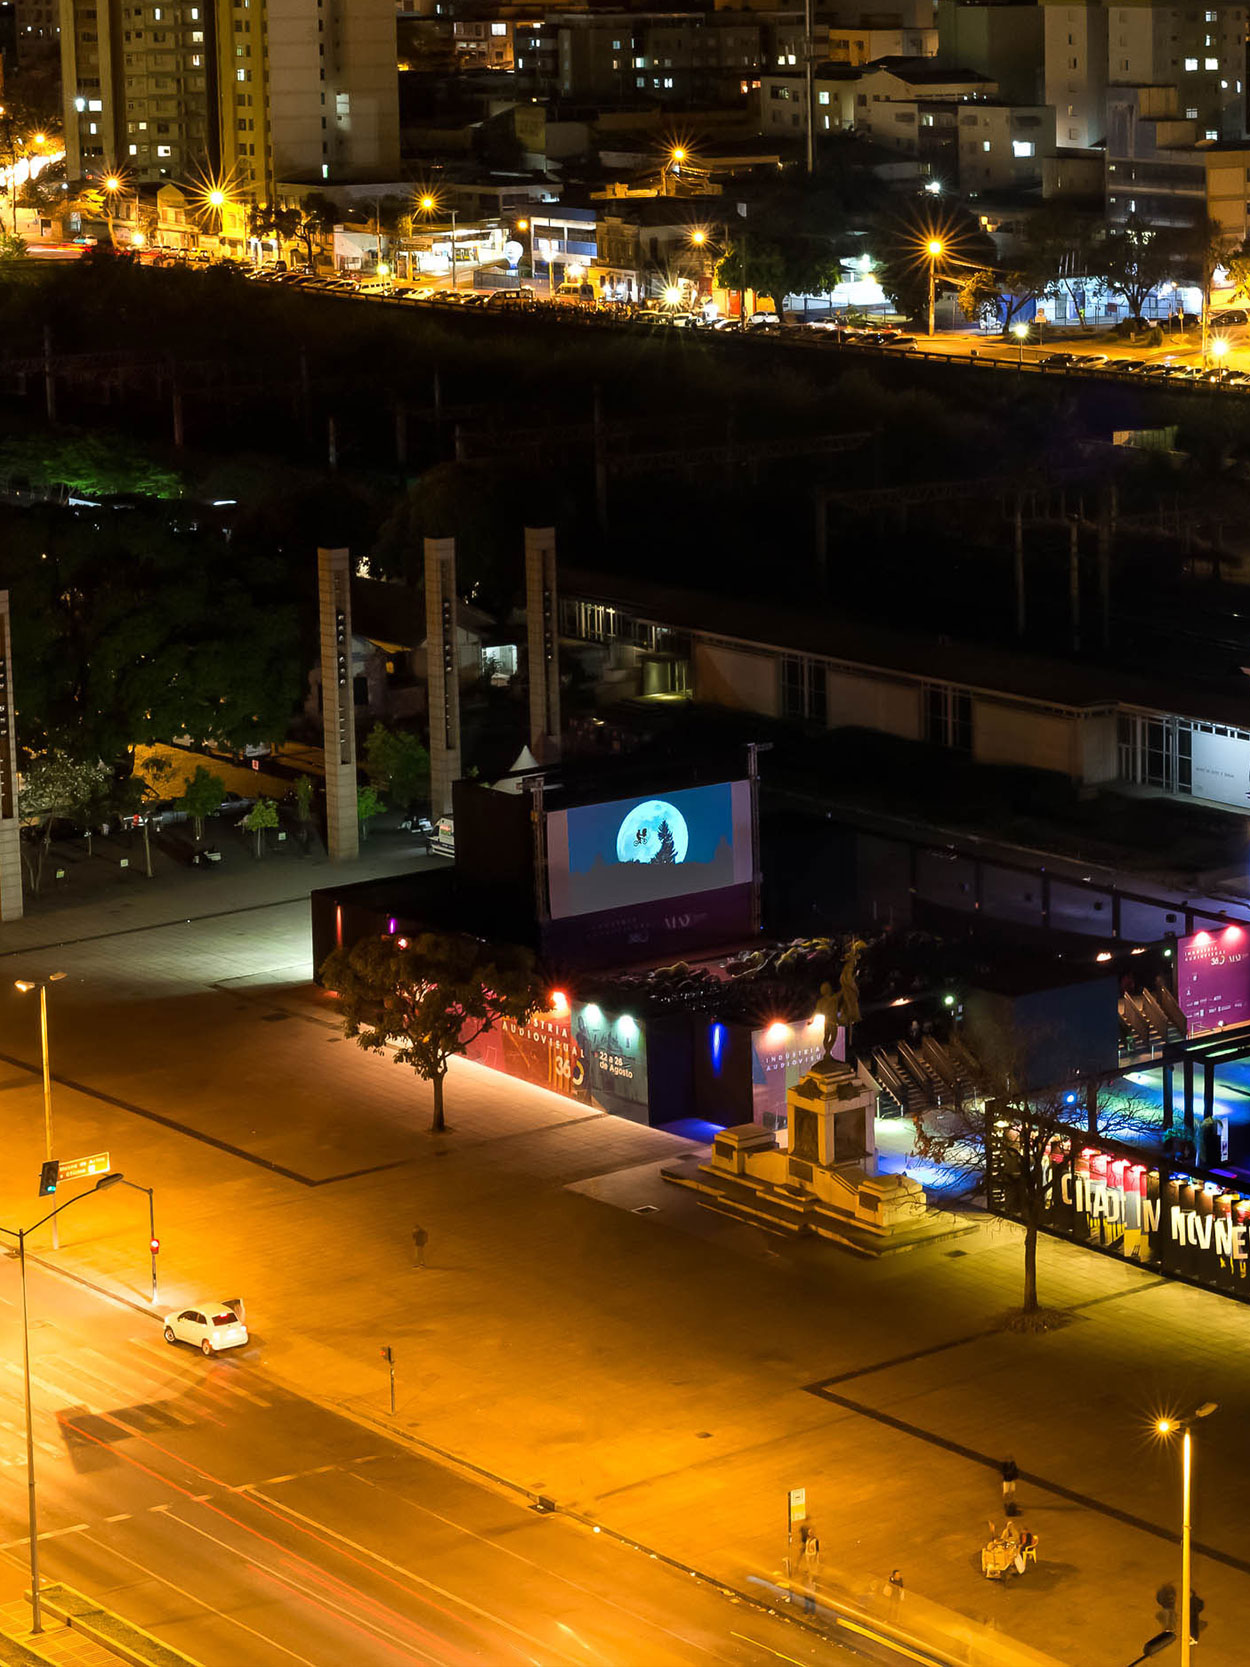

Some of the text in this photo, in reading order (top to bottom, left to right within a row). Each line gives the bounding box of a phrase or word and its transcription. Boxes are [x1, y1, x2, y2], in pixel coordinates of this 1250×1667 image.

[502, 1020, 585, 1059] AUDIOVISUAL
[599, 1051, 608, 1062] 22
[609, 1056, 614, 1064] a
[766, 1054, 821, 1072] AUDIOVISU
[599, 1061, 633, 1079] de Agosto
